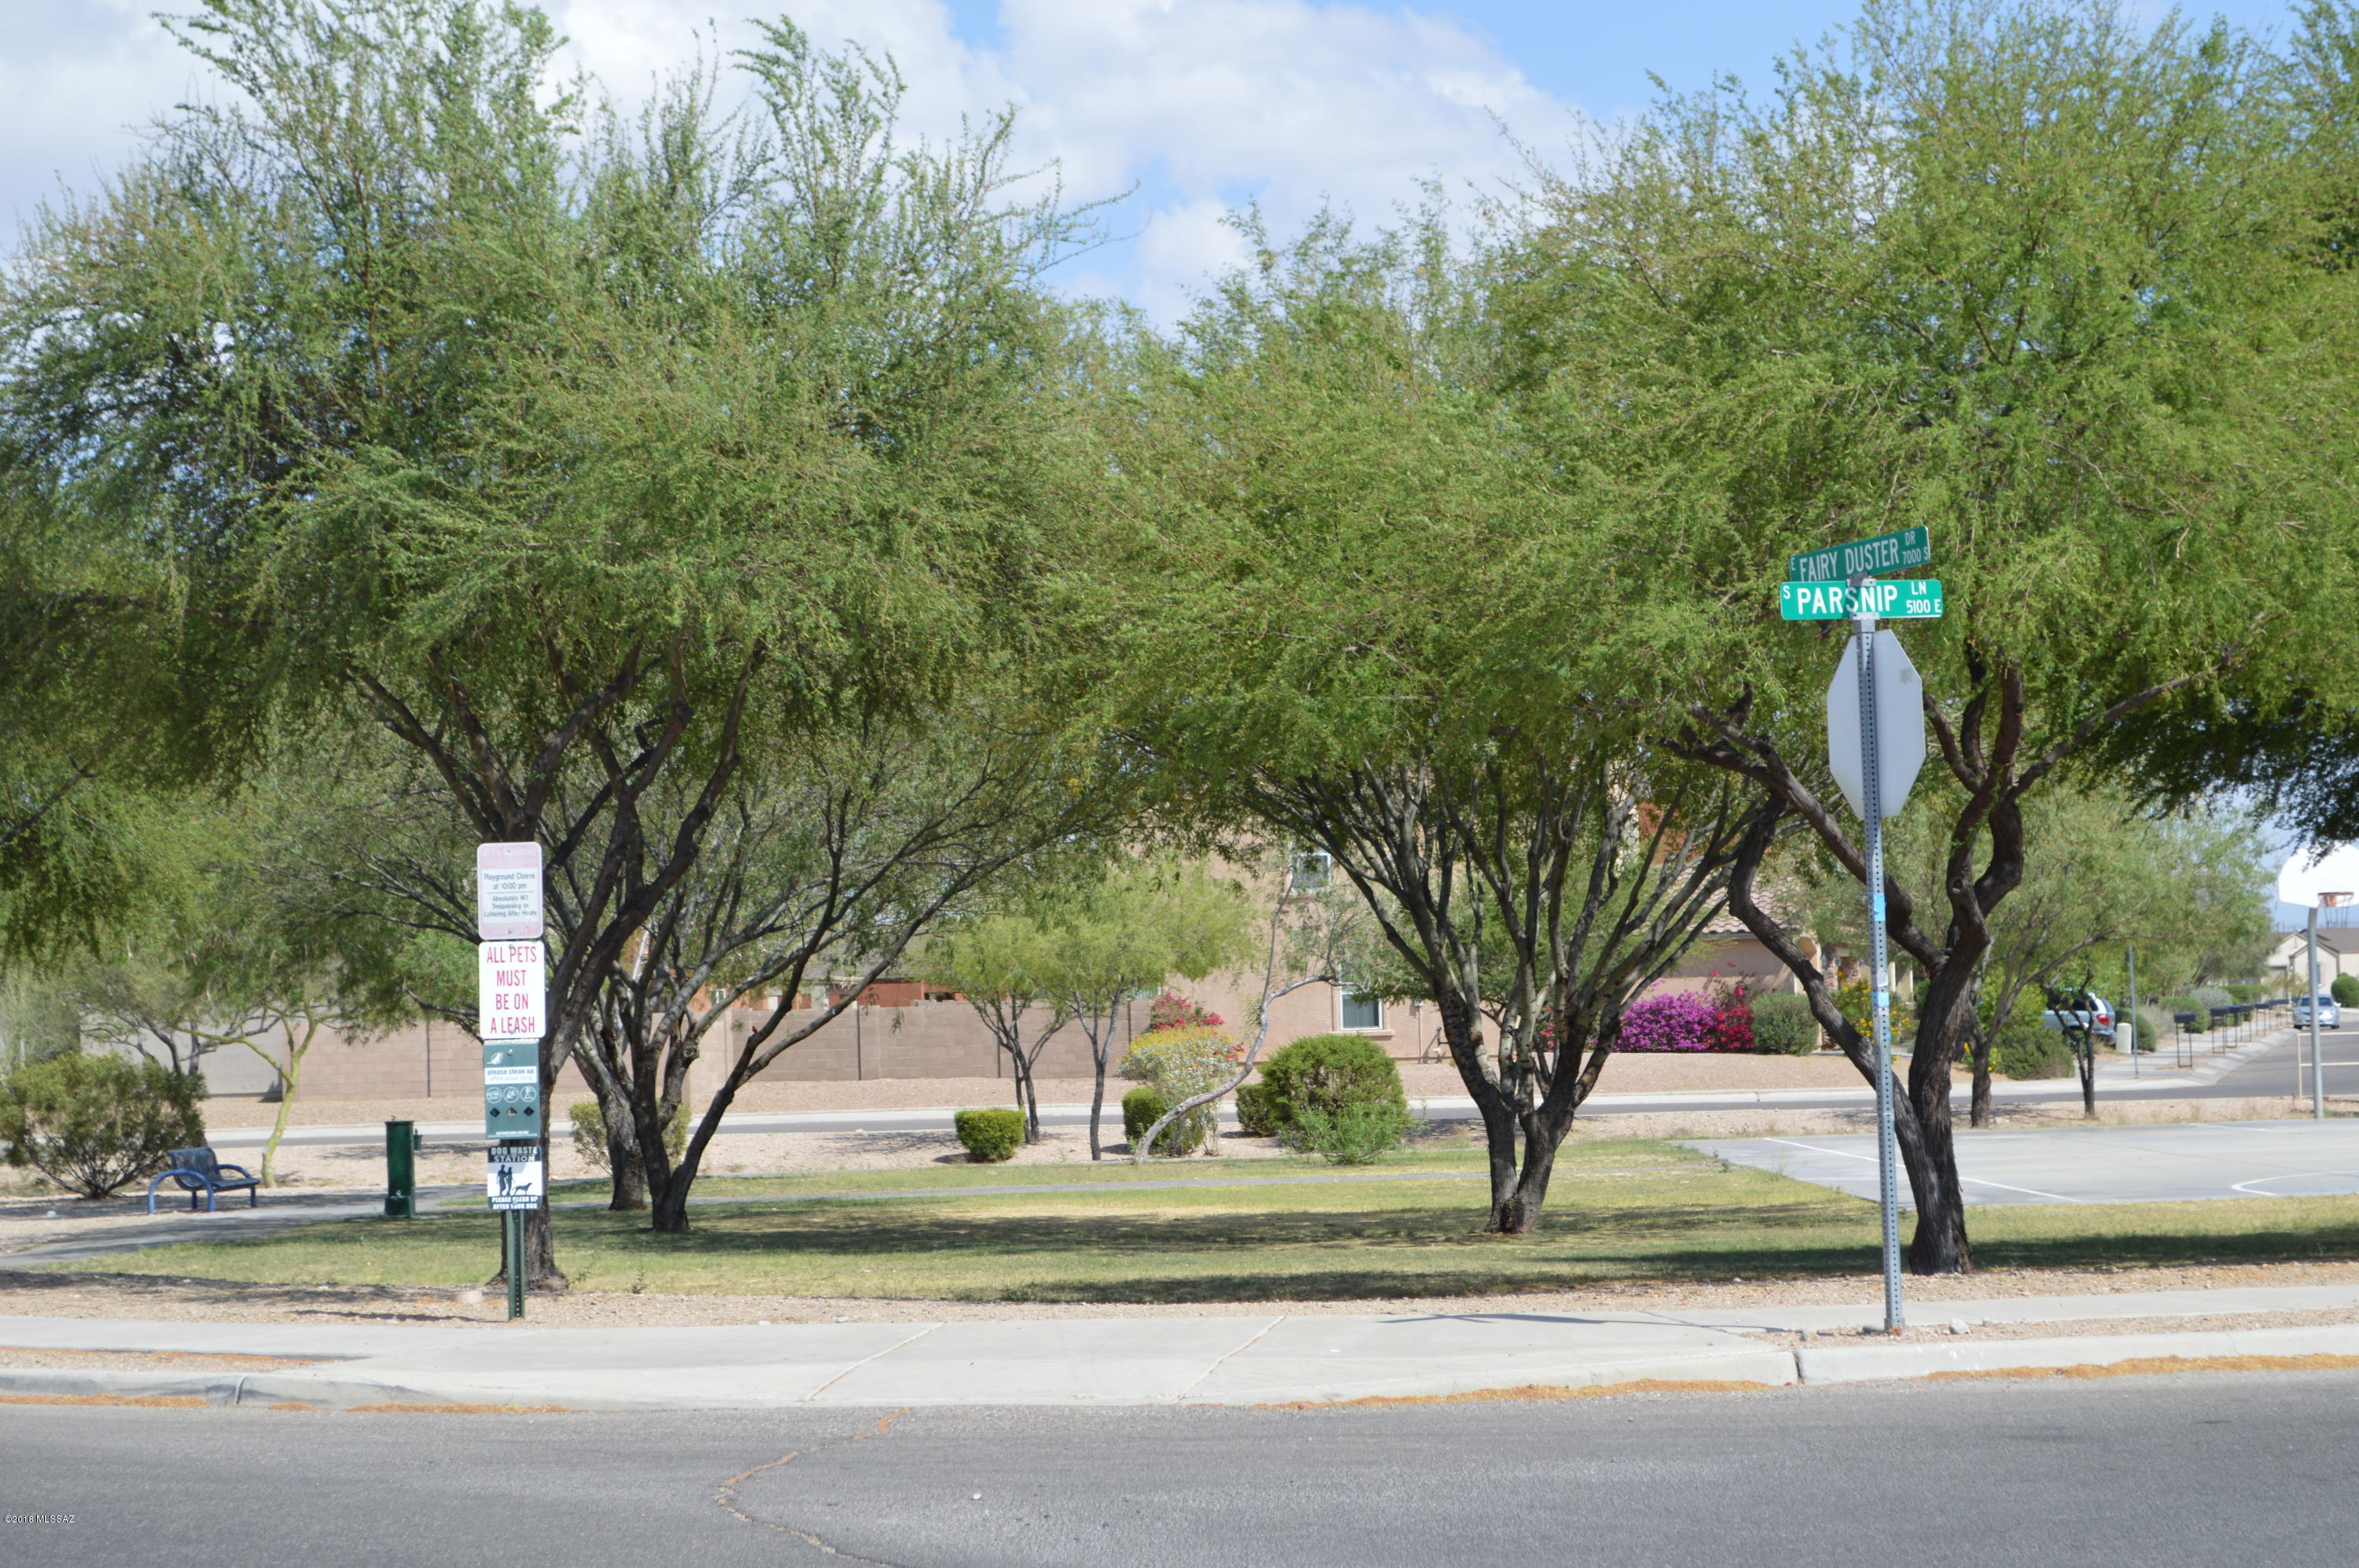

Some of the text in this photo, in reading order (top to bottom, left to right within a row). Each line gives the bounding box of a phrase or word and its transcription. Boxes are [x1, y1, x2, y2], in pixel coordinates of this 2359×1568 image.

[1790, 531, 1916, 581] E FAIRY DUSTER DR
[1902, 547, 1930, 565] 7000 S
[1783, 581, 1927, 615] S PARSNIP LN
[1906, 599, 1942, 614] 5100 E
[487, 946, 536, 963] ALL PETS
[497, 970, 526, 986] MUST
[495, 993, 528, 1010] BE ON
[491, 1016, 535, 1033] A LEASH
[491, 1146, 538, 1155] DOG WASTE
